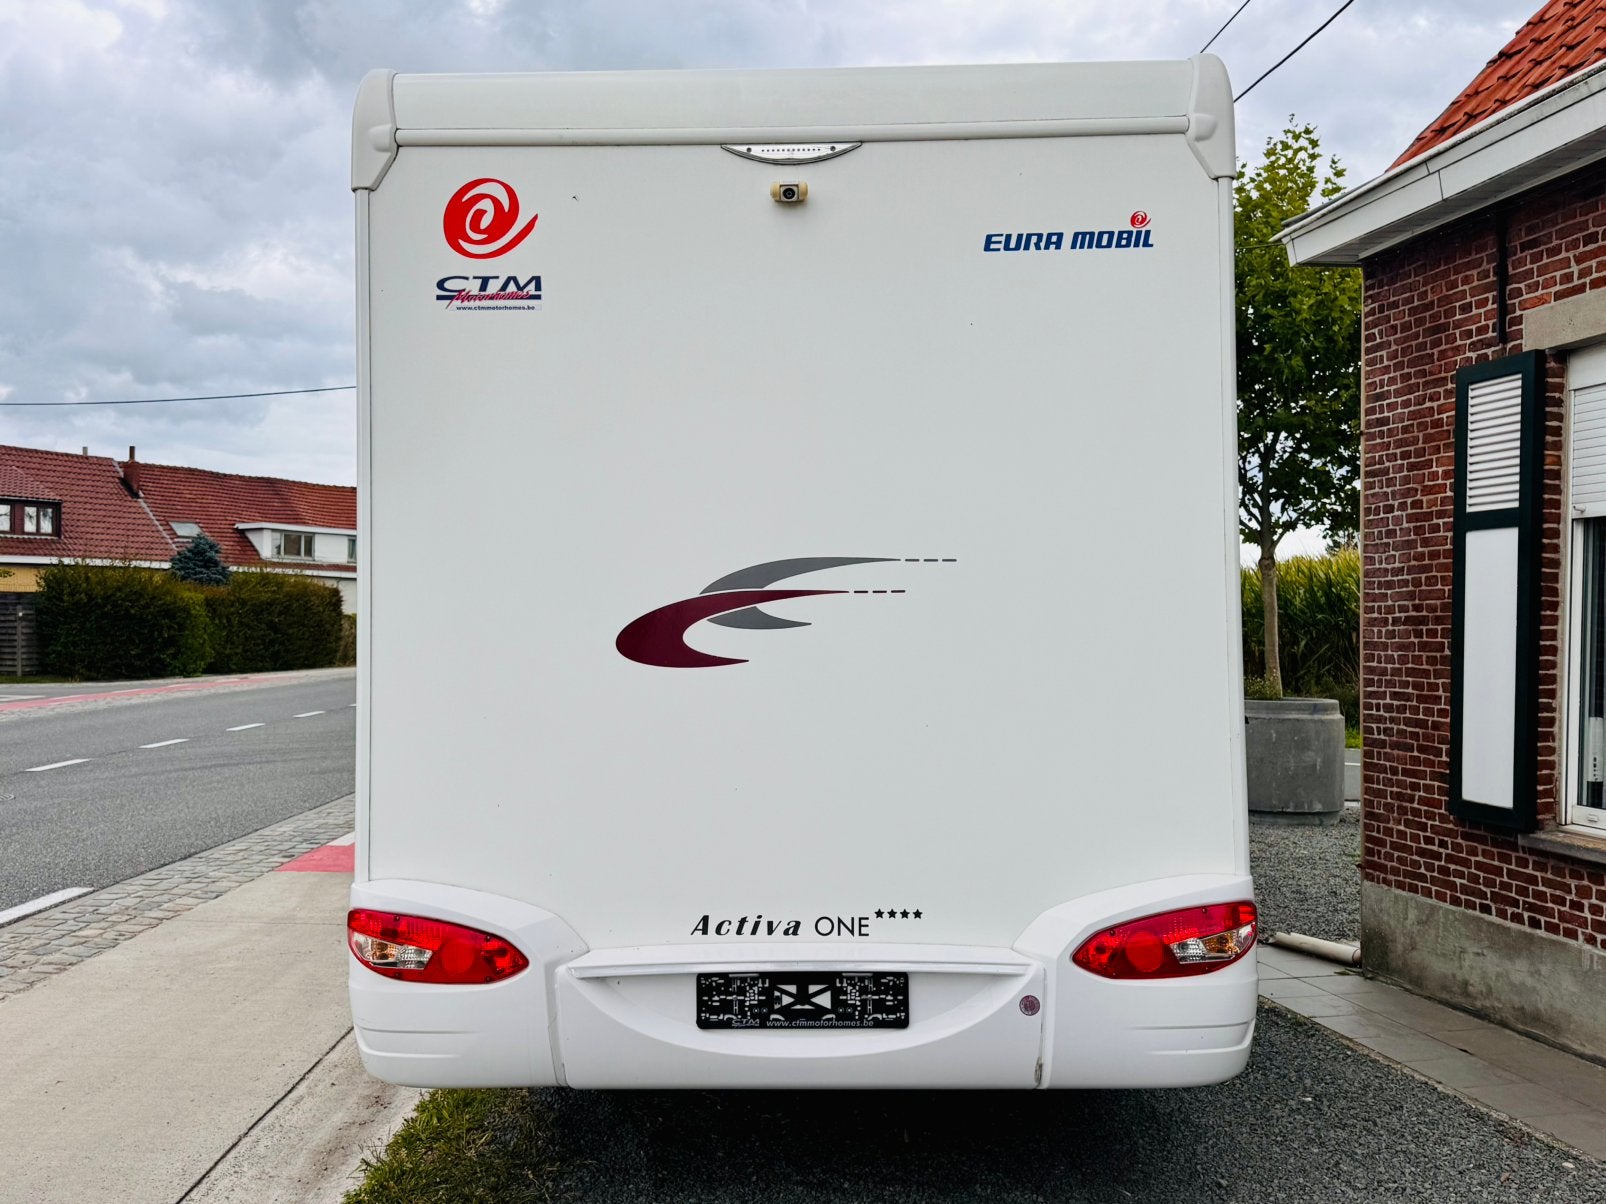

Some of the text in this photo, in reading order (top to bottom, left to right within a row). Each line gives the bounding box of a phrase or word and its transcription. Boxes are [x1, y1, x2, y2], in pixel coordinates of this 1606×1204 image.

[983, 229, 1154, 252] EURA MOBIL
[436, 276, 542, 293] CTM
[690, 914, 870, 937] Activa ONE
[766, 1018, 874, 1028] www.ctmmotorhomes.be
